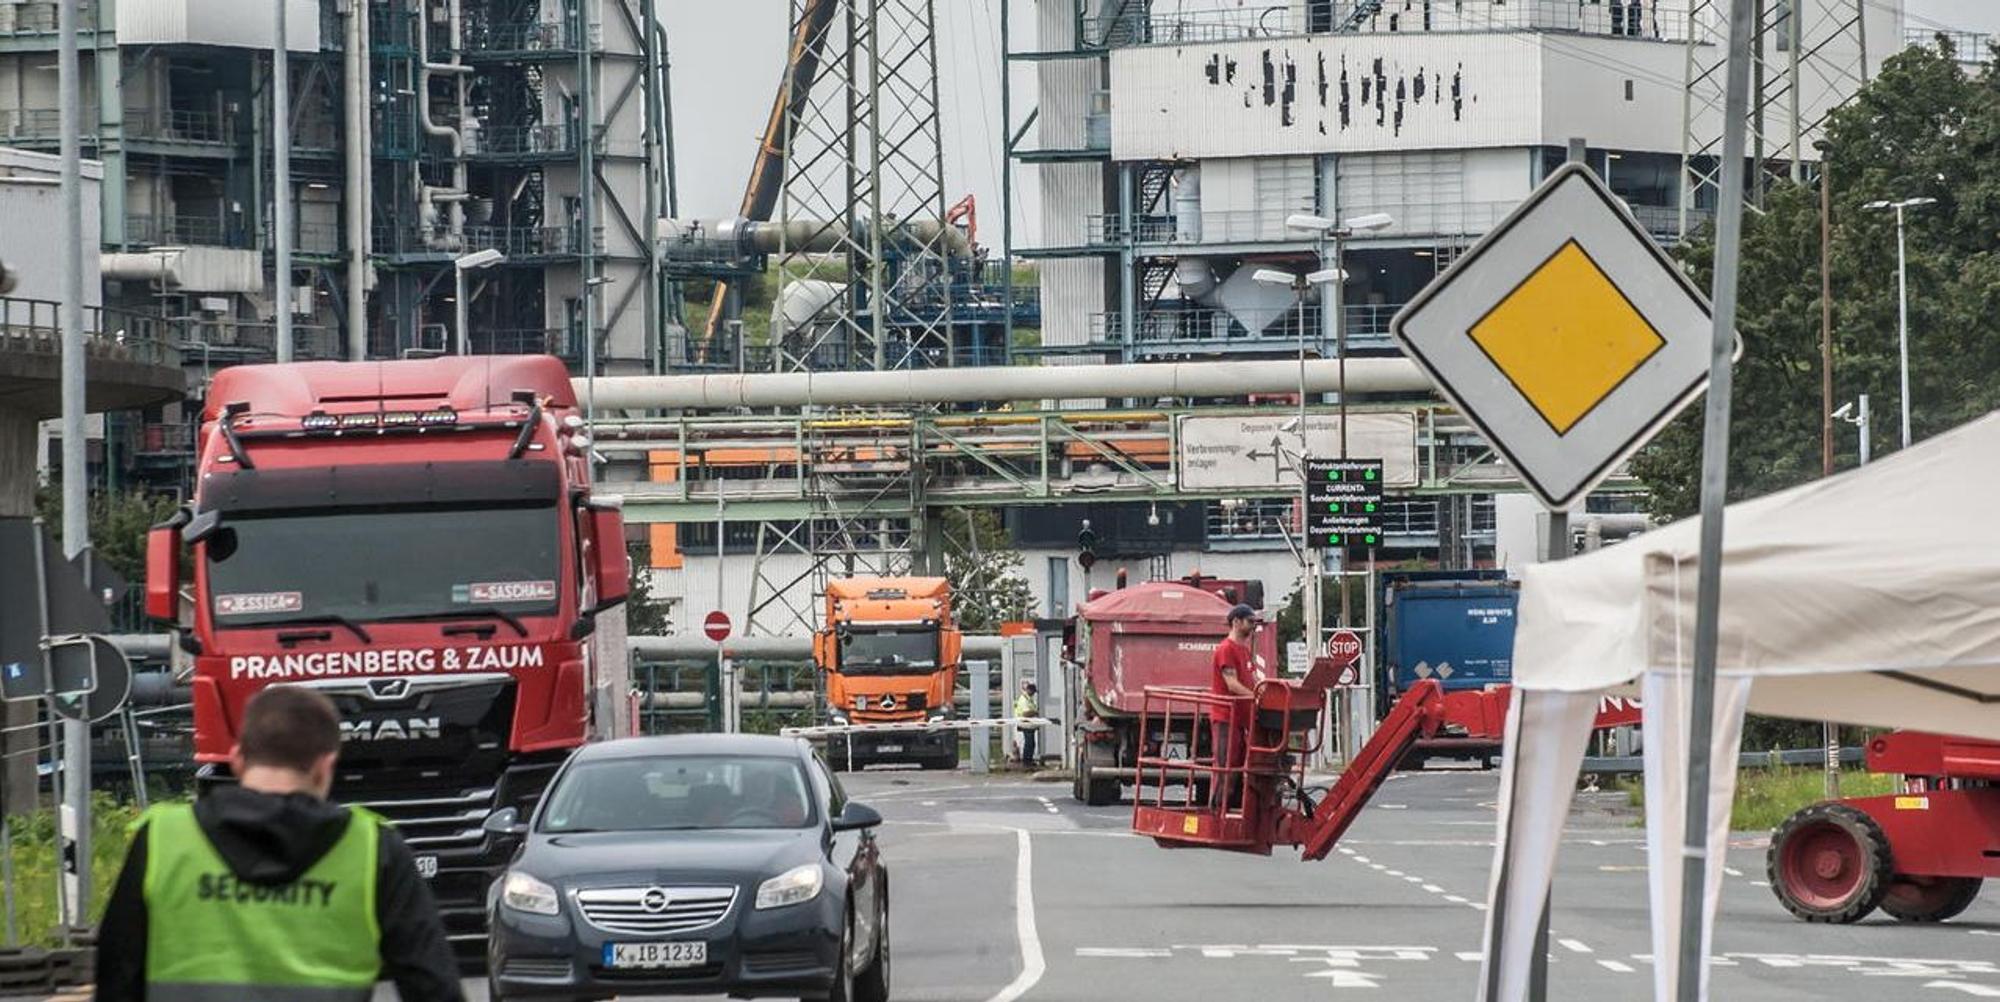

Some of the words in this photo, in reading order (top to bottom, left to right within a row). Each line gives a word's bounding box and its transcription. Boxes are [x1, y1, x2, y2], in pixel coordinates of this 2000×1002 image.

[1326, 485, 1365, 493] CURRENTA
[488, 584, 536, 599] SASCHA
[231, 596, 286, 611] JESSICA
[1331, 641, 1358, 654] STOP
[230, 650, 436, 679] PRANGENBERG
[442, 648, 461, 669] &
[466, 646, 544, 669] ZAUM
[339, 717, 440, 741] MAN
[1169, 746, 1180, 759] A
[662, 944, 703, 961] 1233
